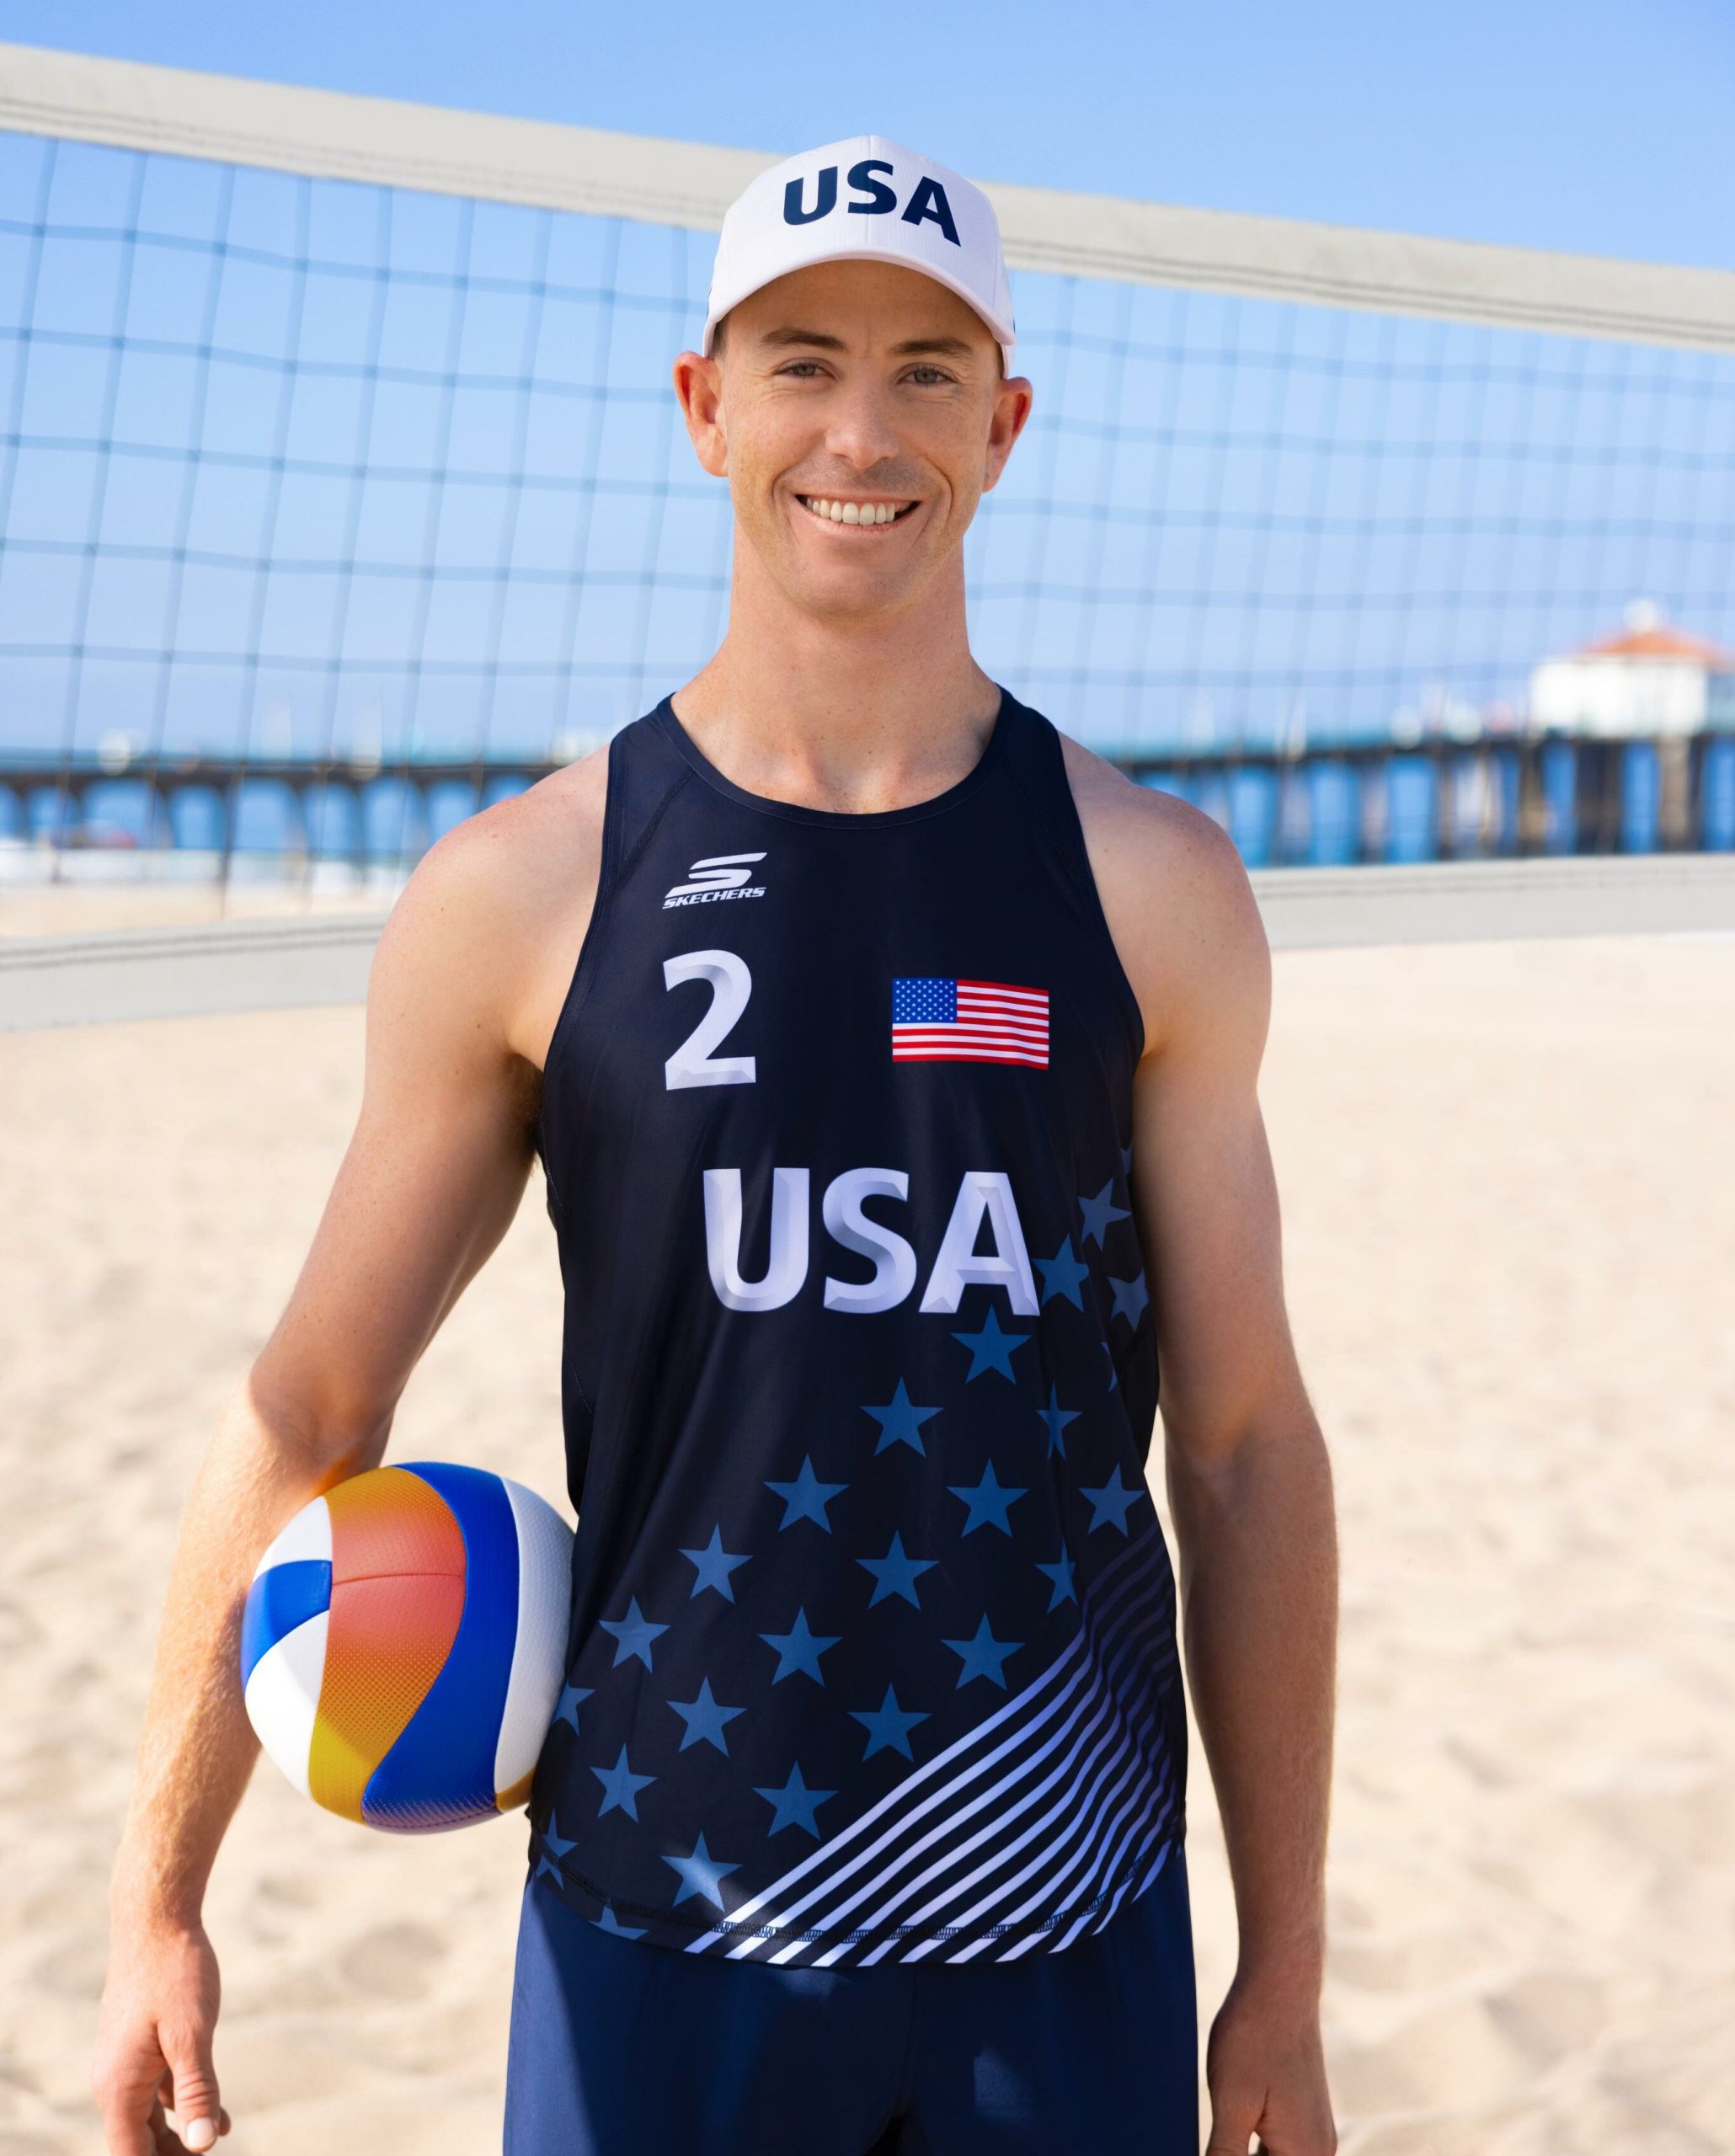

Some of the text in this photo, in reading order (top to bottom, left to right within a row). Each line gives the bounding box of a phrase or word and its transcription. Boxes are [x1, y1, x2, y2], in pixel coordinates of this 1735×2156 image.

[783, 159, 961, 247] USA
[662, 887, 767, 910] SKECHERS
[663, 949, 756, 1091] 2
[703, 1167, 1041, 1316] USA
